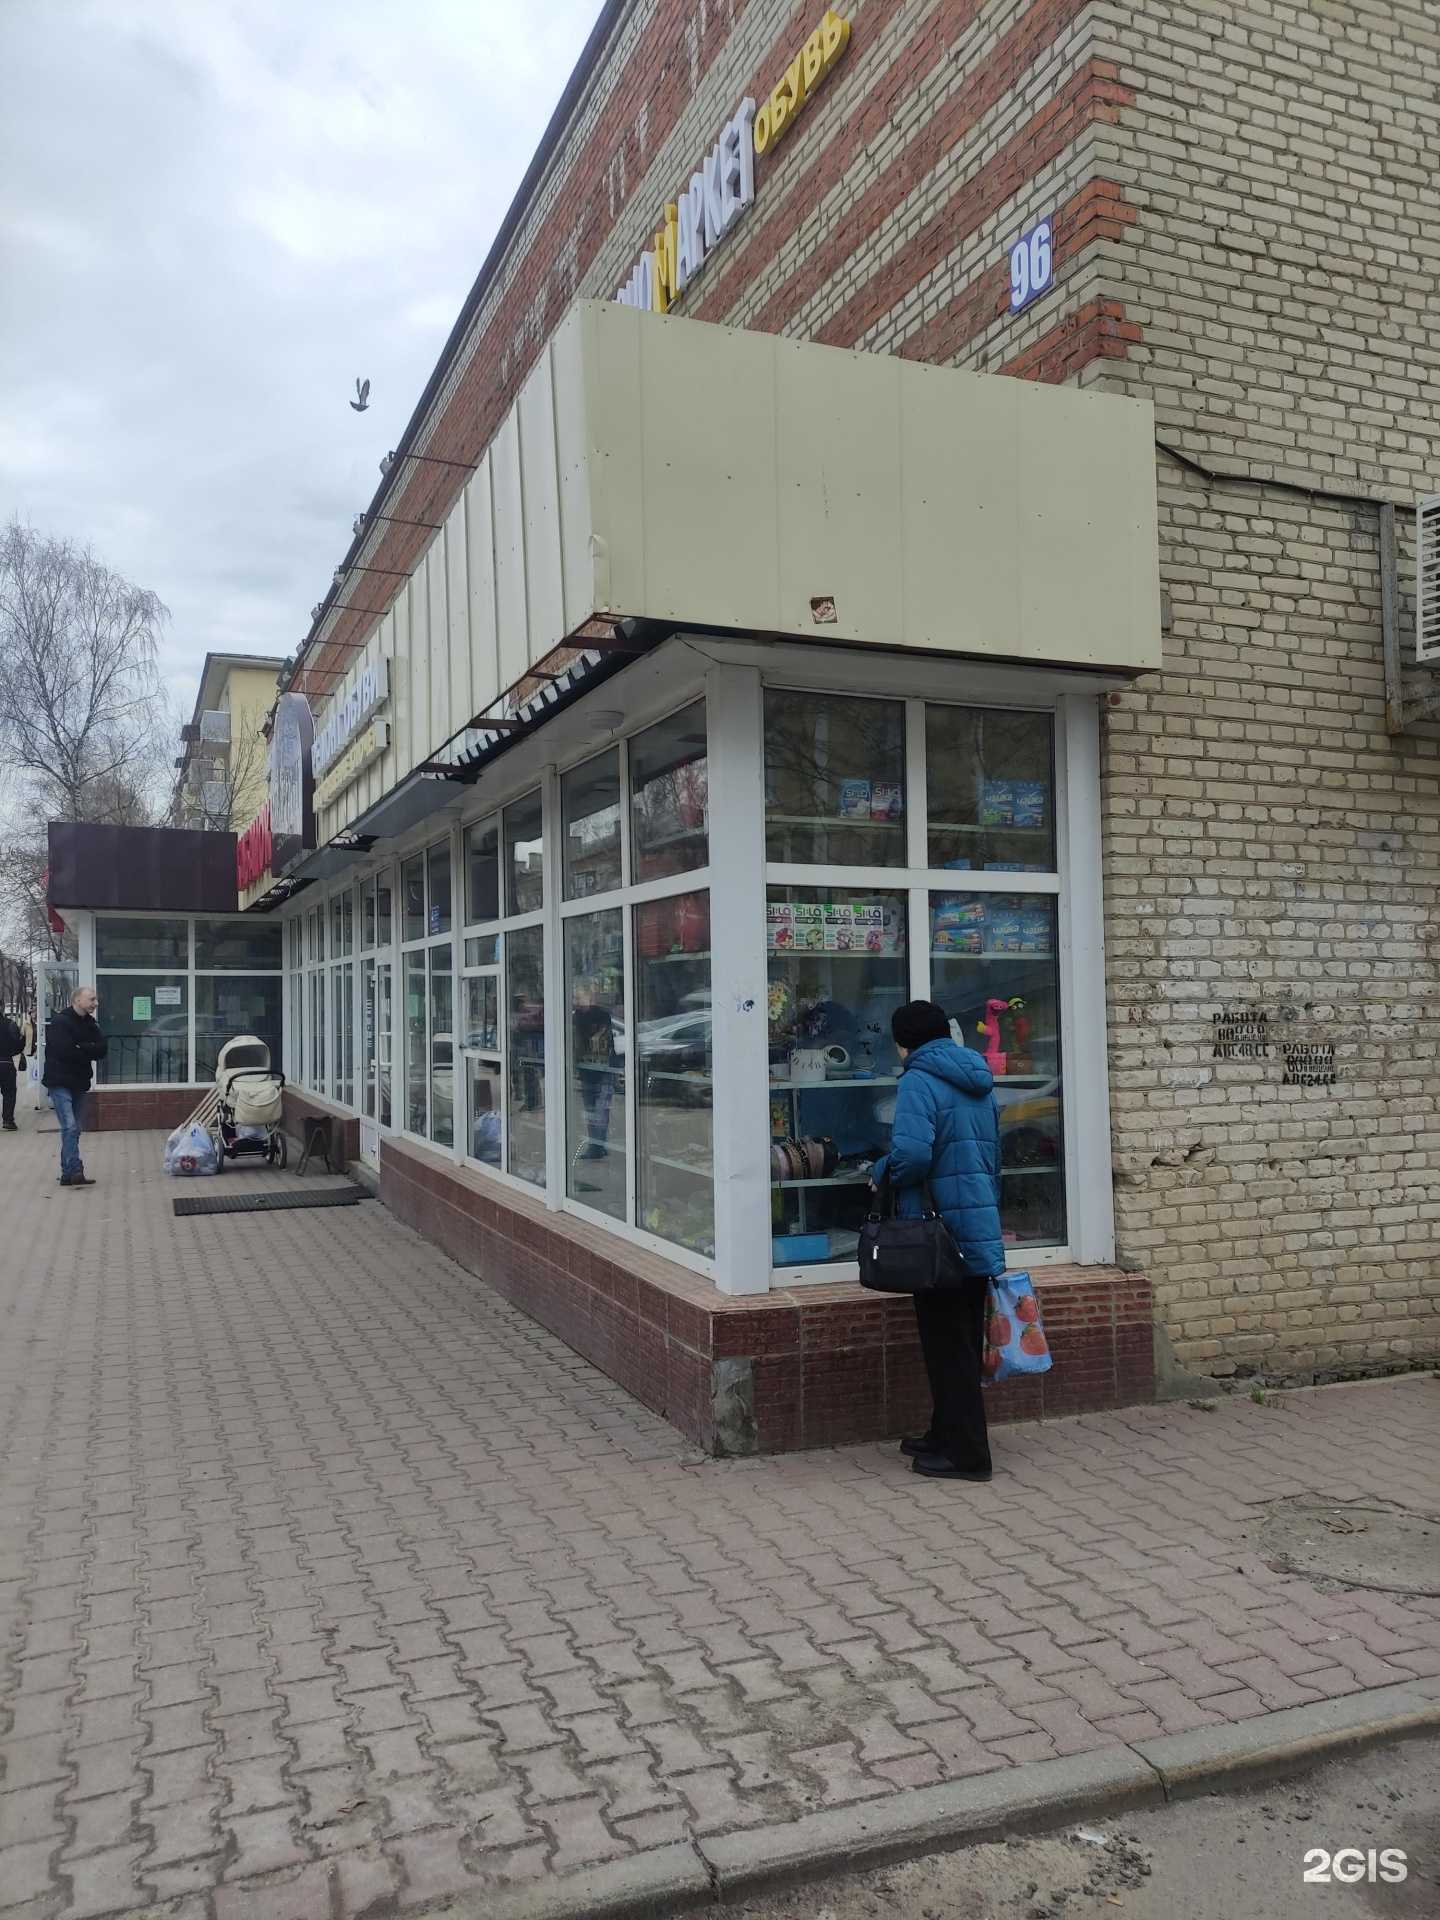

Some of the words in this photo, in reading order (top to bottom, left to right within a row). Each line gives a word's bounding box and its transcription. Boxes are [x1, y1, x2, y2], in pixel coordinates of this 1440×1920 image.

[754, 10, 851, 155] ОБУВЬ
[1011, 223, 1051, 308] 96
[1213, 1011, 1268, 1024] РАБОТА
[1282, 1043, 1336, 1056] РАБОТА
